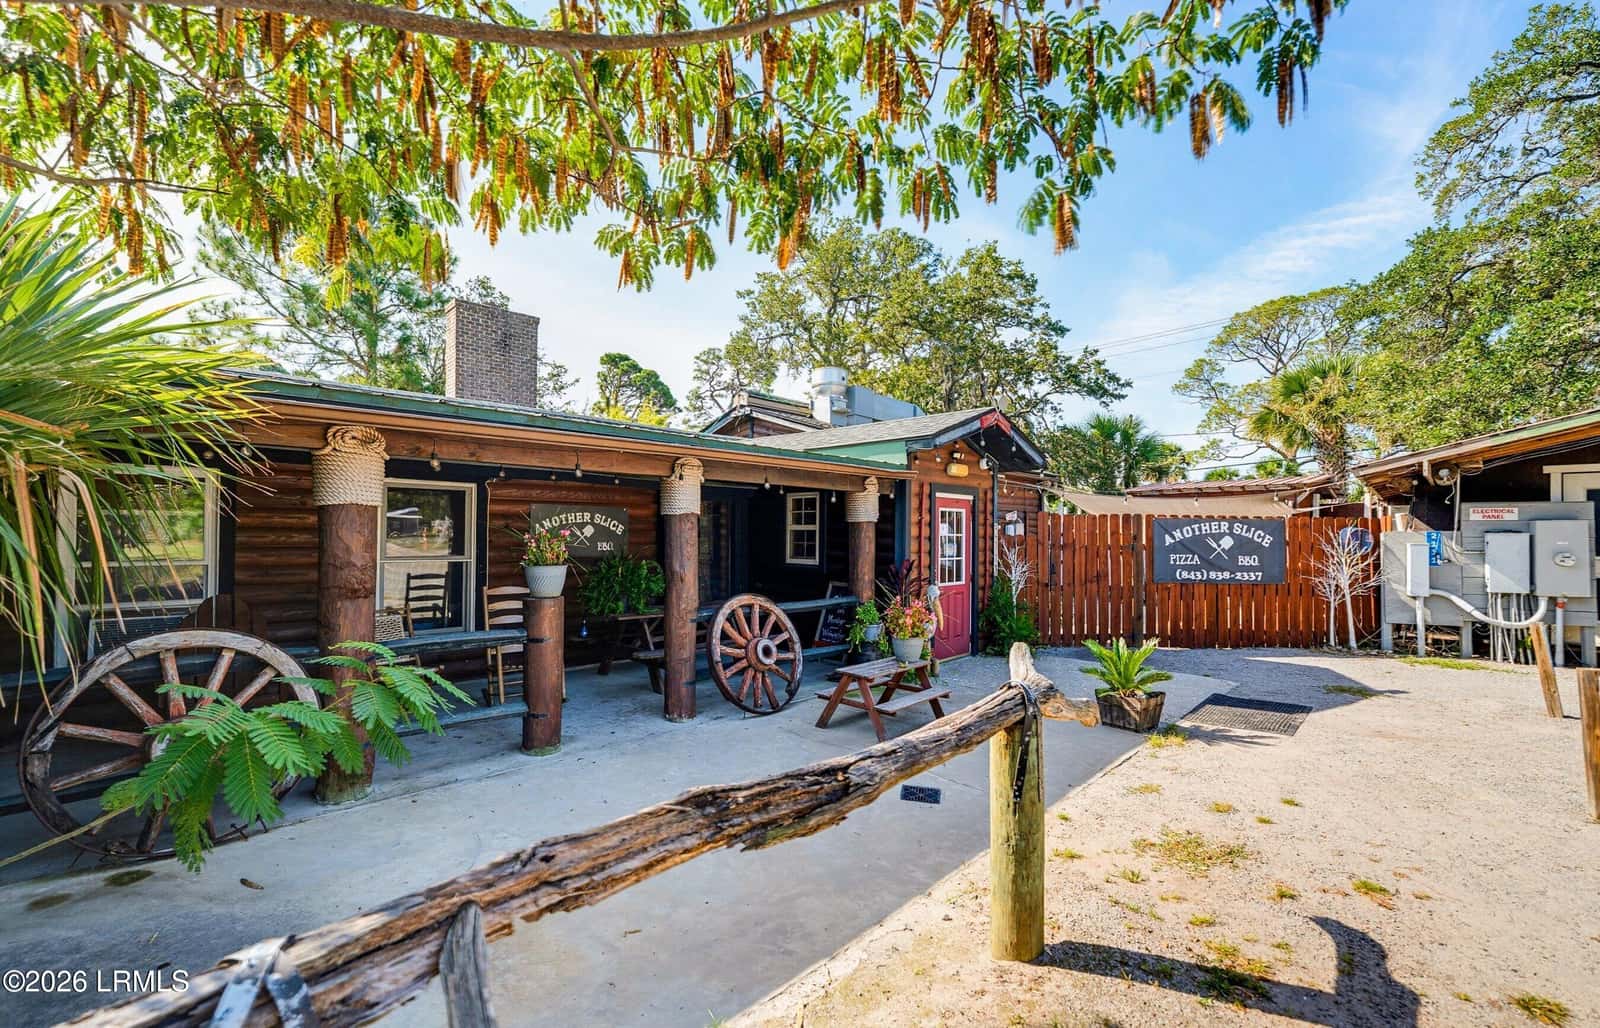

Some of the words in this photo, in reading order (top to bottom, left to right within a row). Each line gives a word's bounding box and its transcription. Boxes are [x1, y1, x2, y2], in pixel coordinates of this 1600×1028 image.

[535, 512, 591, 534] ANOTHER
[593, 513, 625, 535] SLICE
[1164, 521, 1229, 546] ANOTHER
[1233, 522, 1273, 547] SLICE
[1169, 554, 1200, 565] PIZZA
[1238, 555, 1259, 566] BBQ
[1175, 569, 1207, 581] (843)
[1208, 571, 1263, 581] 838-2337
